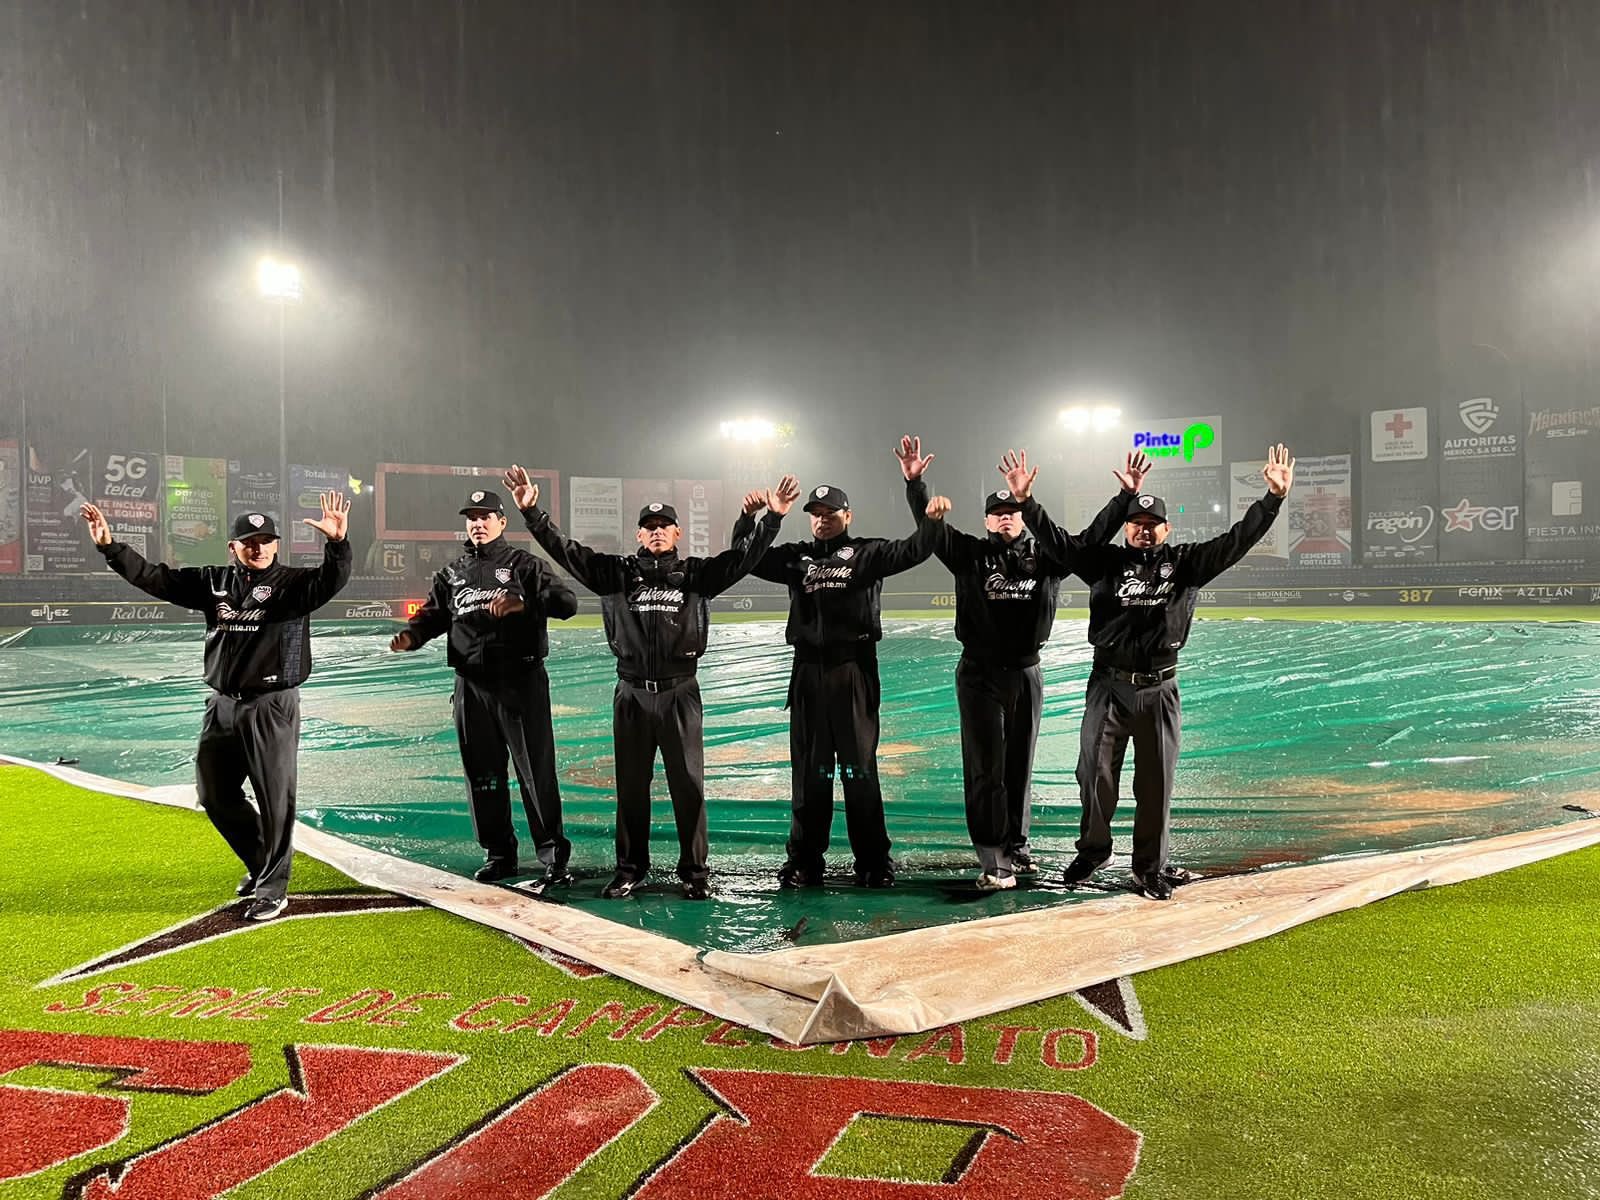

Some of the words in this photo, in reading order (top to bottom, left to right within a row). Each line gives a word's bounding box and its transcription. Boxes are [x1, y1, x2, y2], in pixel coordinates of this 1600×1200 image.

[1133, 432, 1182, 448] Pintu
[1444, 435, 1517, 449] AUTORITAS
[104, 455, 147, 482] 5G
[29, 475, 52, 485] UVP
[104, 483, 148, 498] telcel
[96, 499, 109, 508] TE
[114, 510, 153, 520] EQUIPO
[116, 523, 154, 534] Planes
[689, 499, 709, 558] ECATE
[1528, 527, 1577, 537] FIESTA
[454, 587, 509, 608] Caliente
[1399, 590, 1433, 603] 387
[137, 606, 165, 620] Cola
[346, 608, 393, 618] Electrolit
[45, 982, 322, 1021] SERIE
[301, 988, 451, 1027] DE
